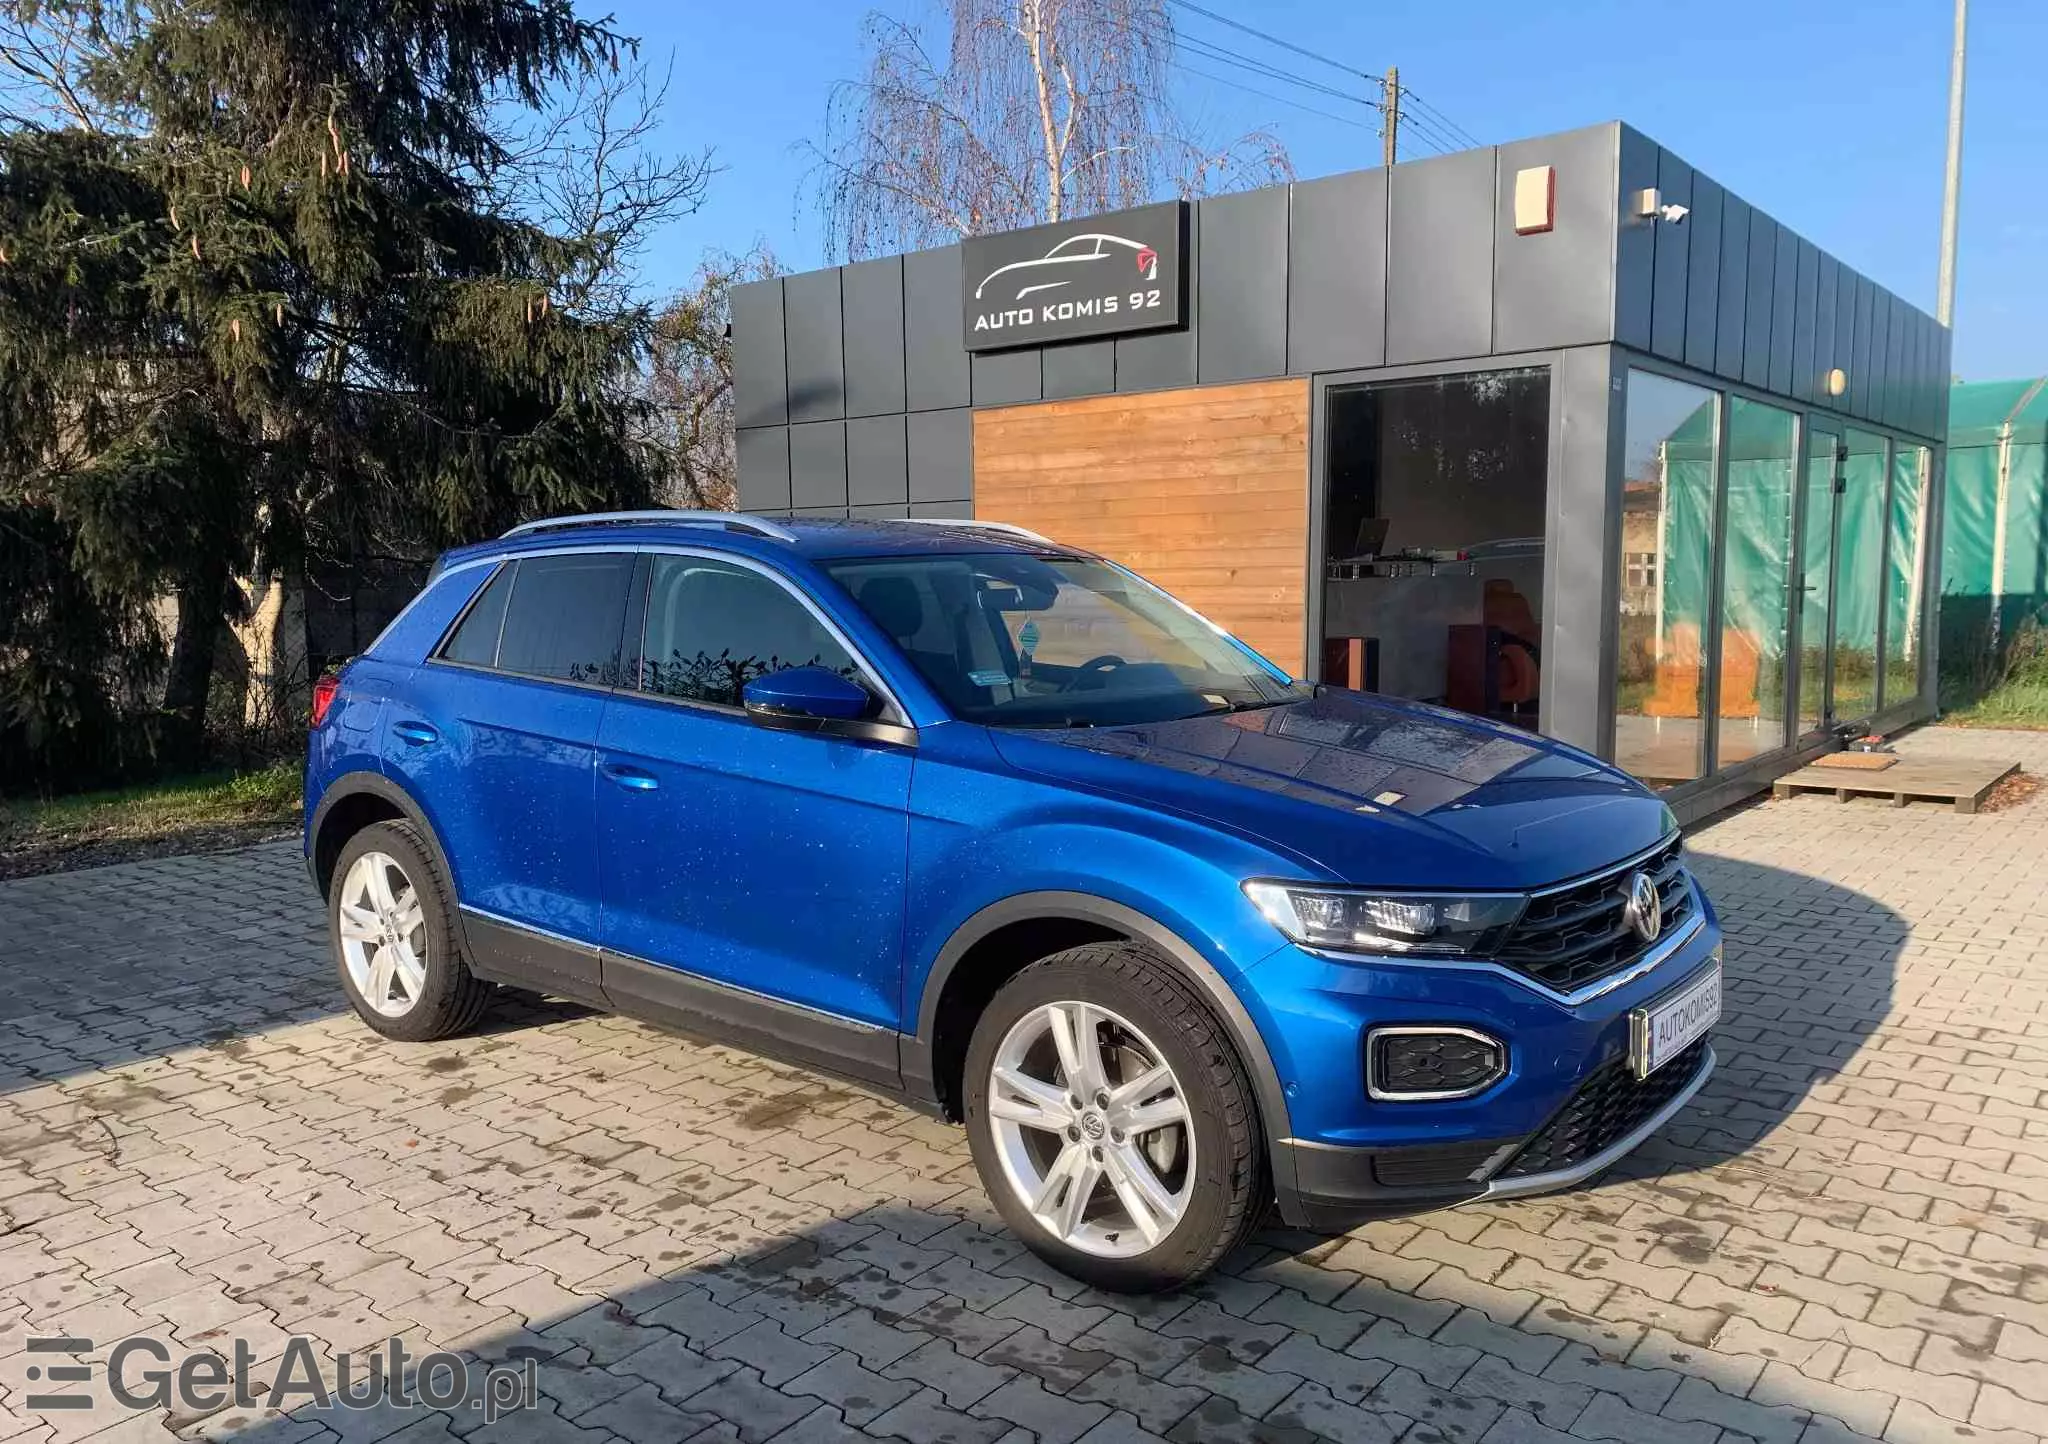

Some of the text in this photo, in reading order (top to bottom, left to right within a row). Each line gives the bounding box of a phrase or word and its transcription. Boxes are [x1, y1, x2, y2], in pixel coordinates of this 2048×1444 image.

[974, 289, 1161, 332] AUTO KOMIS 92
